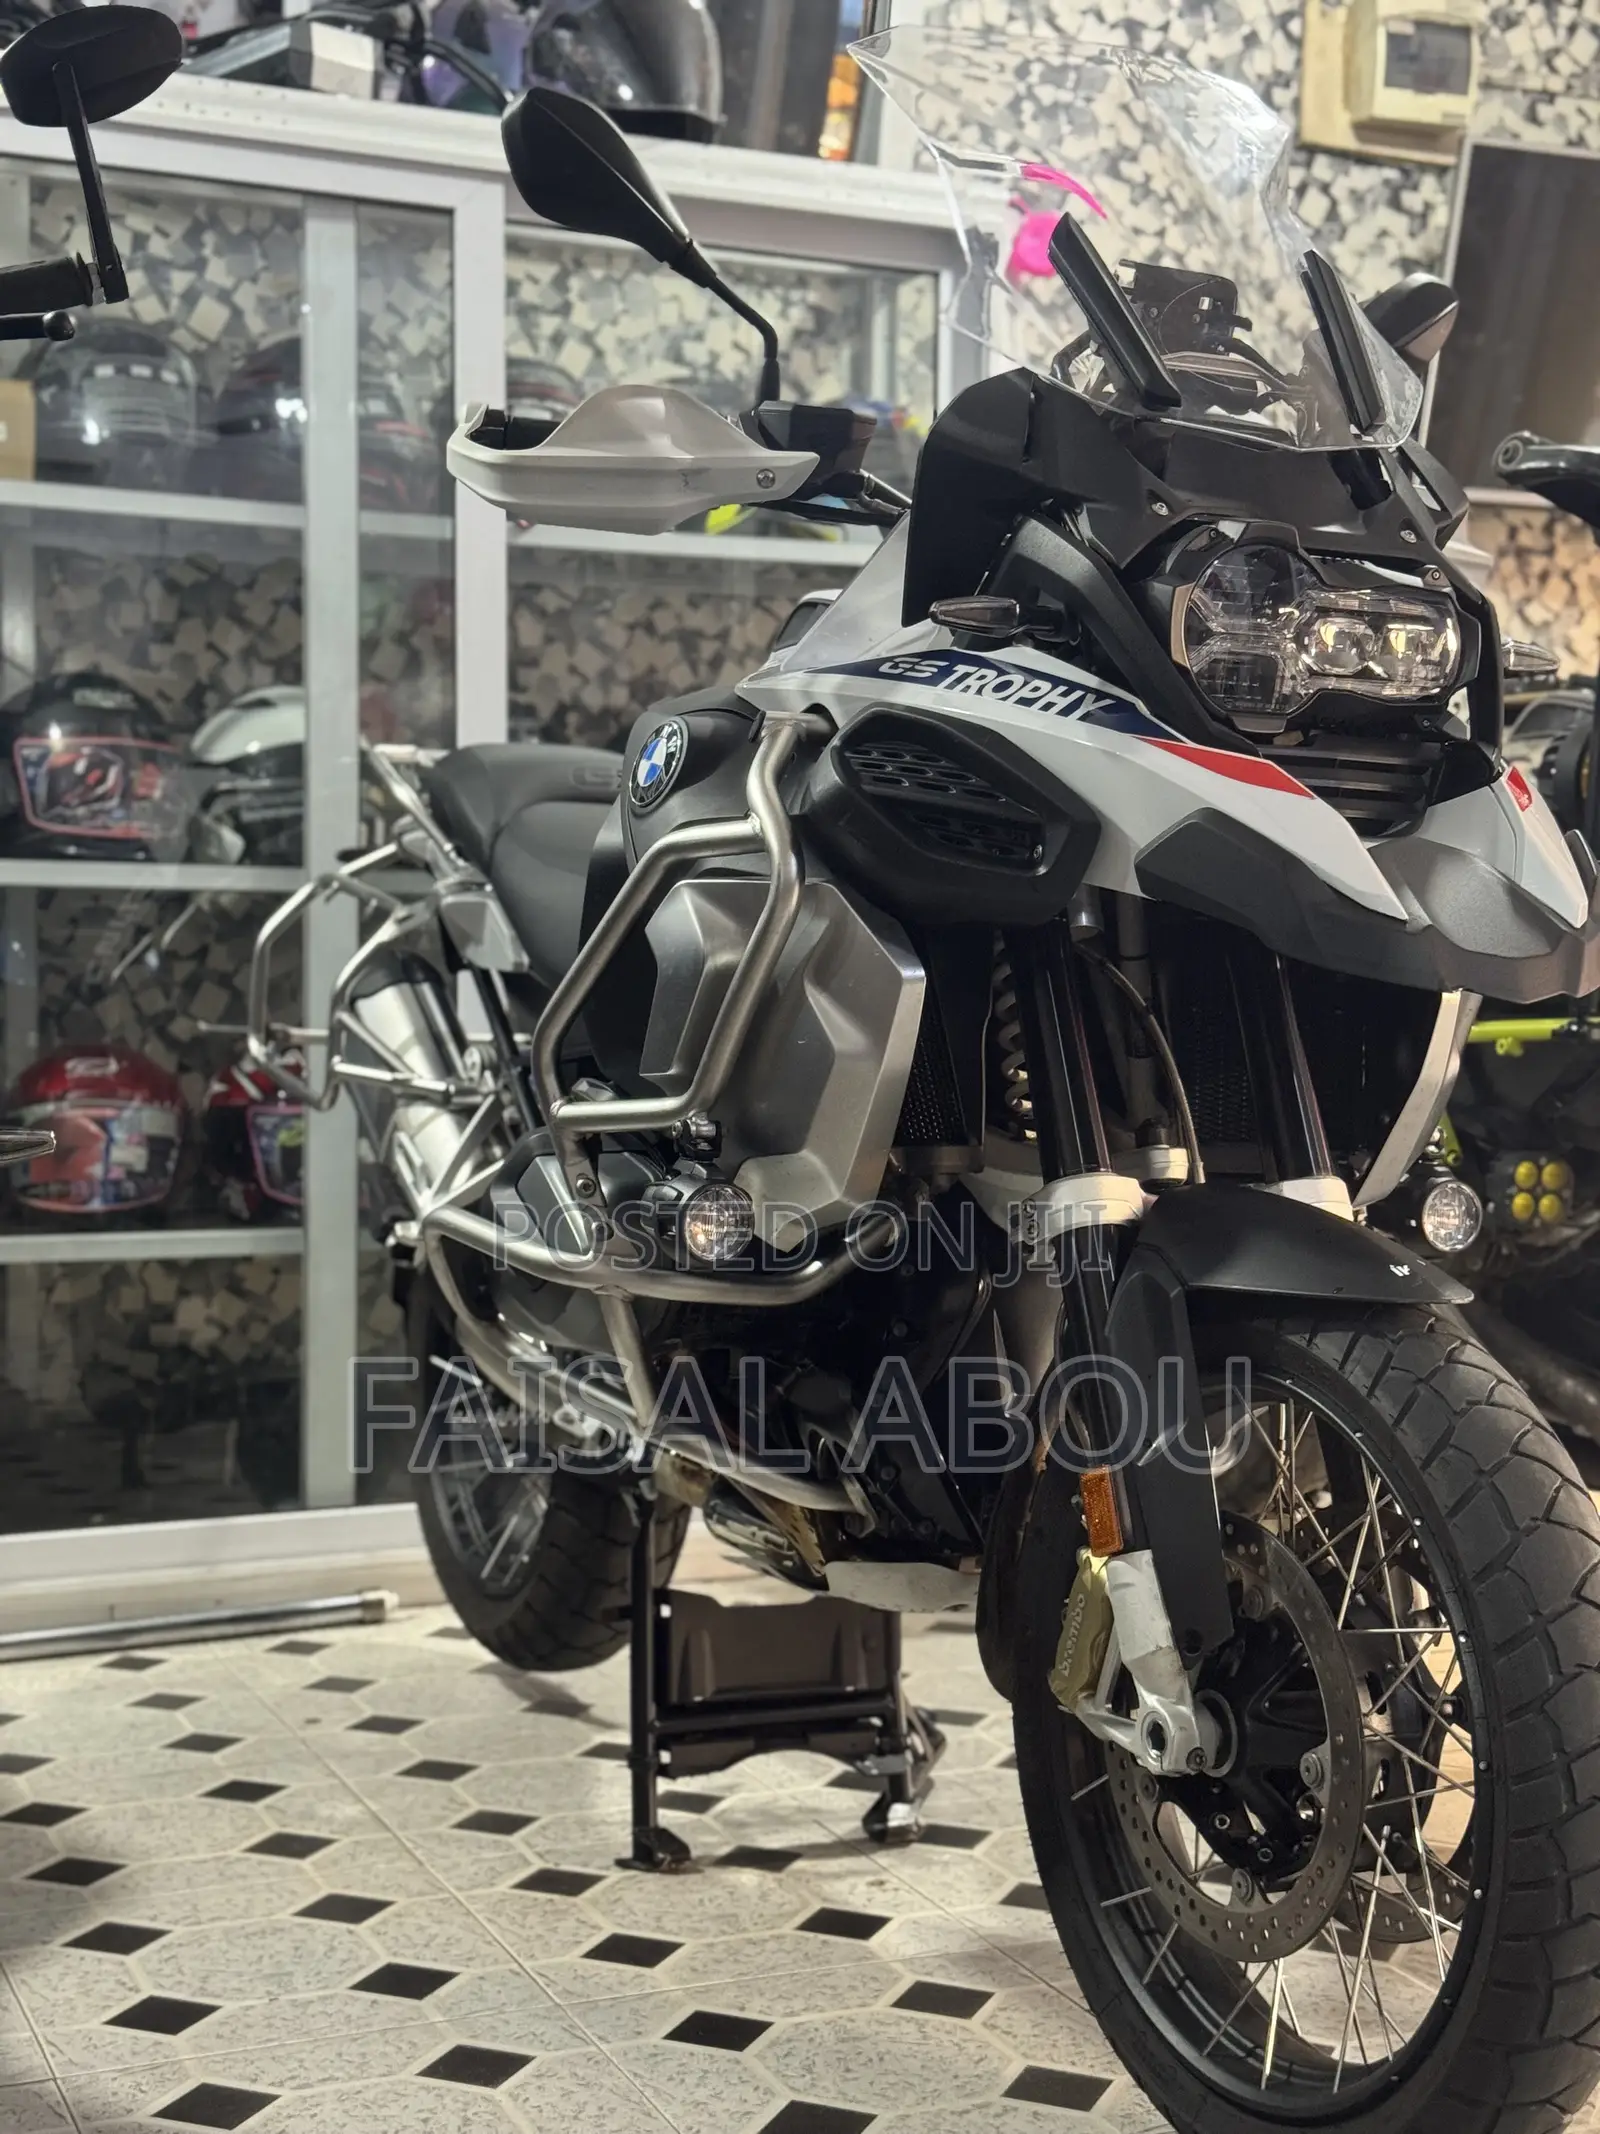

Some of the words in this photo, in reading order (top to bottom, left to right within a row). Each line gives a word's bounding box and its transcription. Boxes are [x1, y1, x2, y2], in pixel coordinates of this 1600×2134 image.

[878, 656, 950, 678] GS
[936, 664, 1117, 721] TROPHY
[1058, 1593, 1086, 1678] brembo
